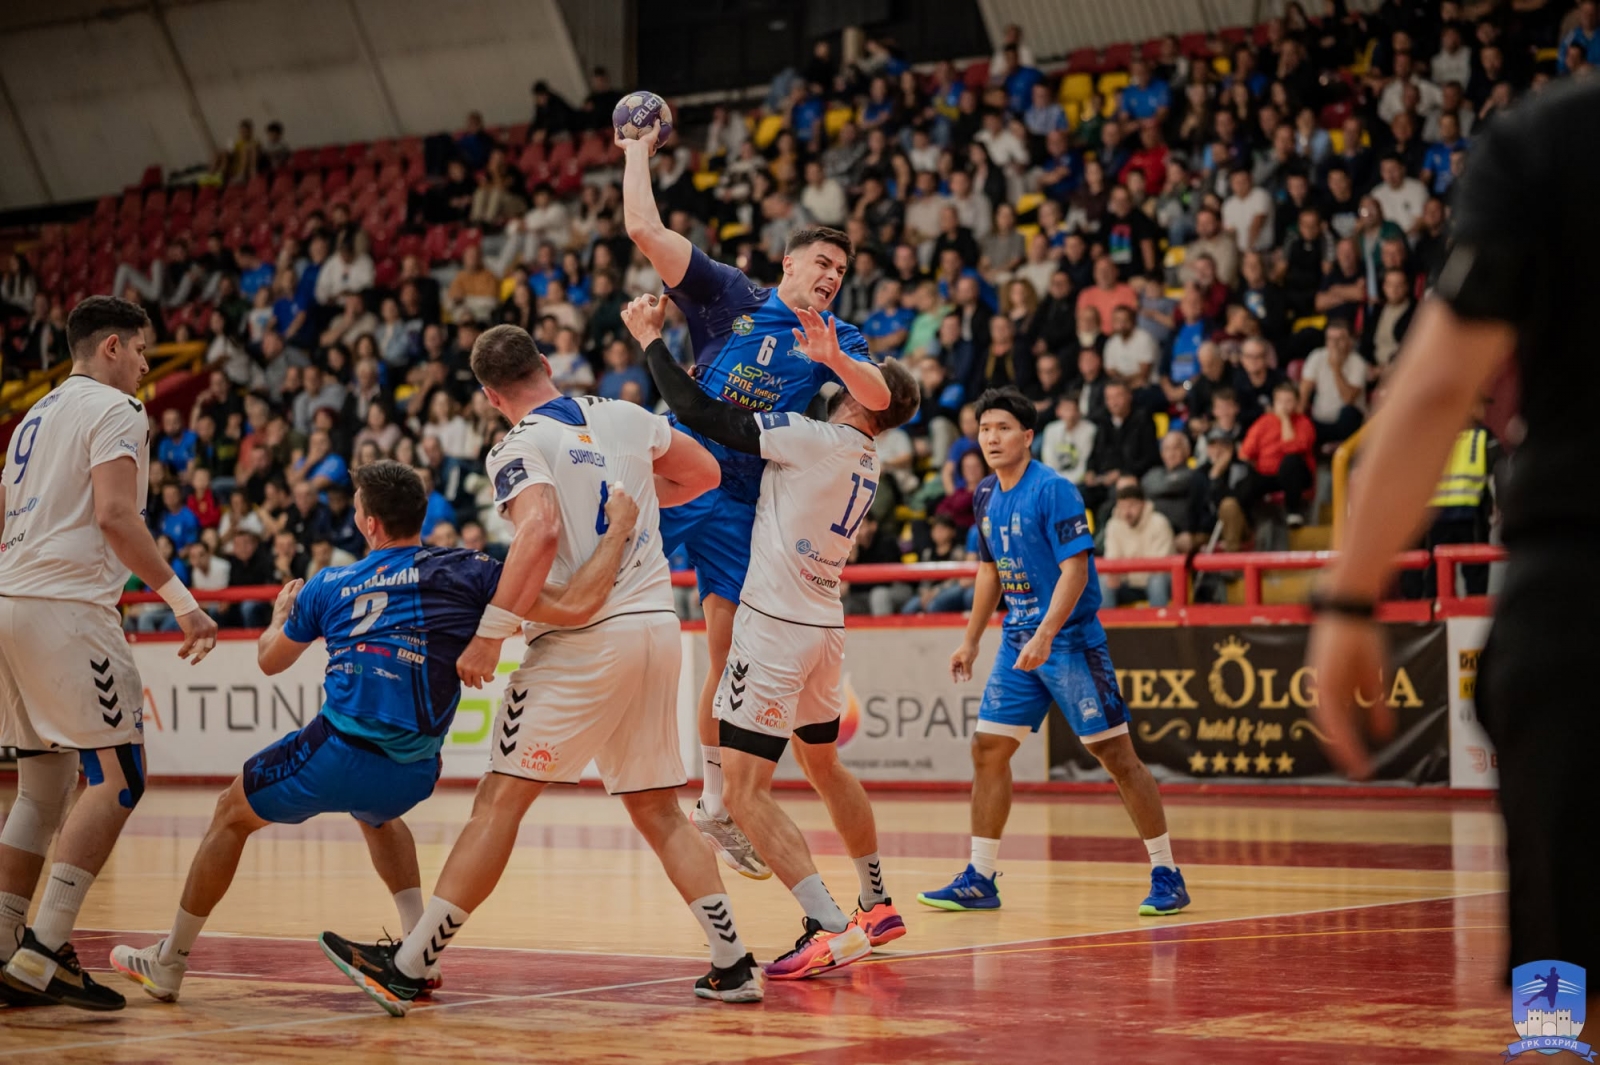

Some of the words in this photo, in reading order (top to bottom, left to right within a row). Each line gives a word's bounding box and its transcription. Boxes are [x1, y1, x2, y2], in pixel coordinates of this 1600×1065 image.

[756, 335, 778, 367] 6
[14, 416, 42, 484] 9
[829, 472, 878, 540] 17
[349, 591, 389, 637] 2
[142, 684, 325, 732] AITONI
